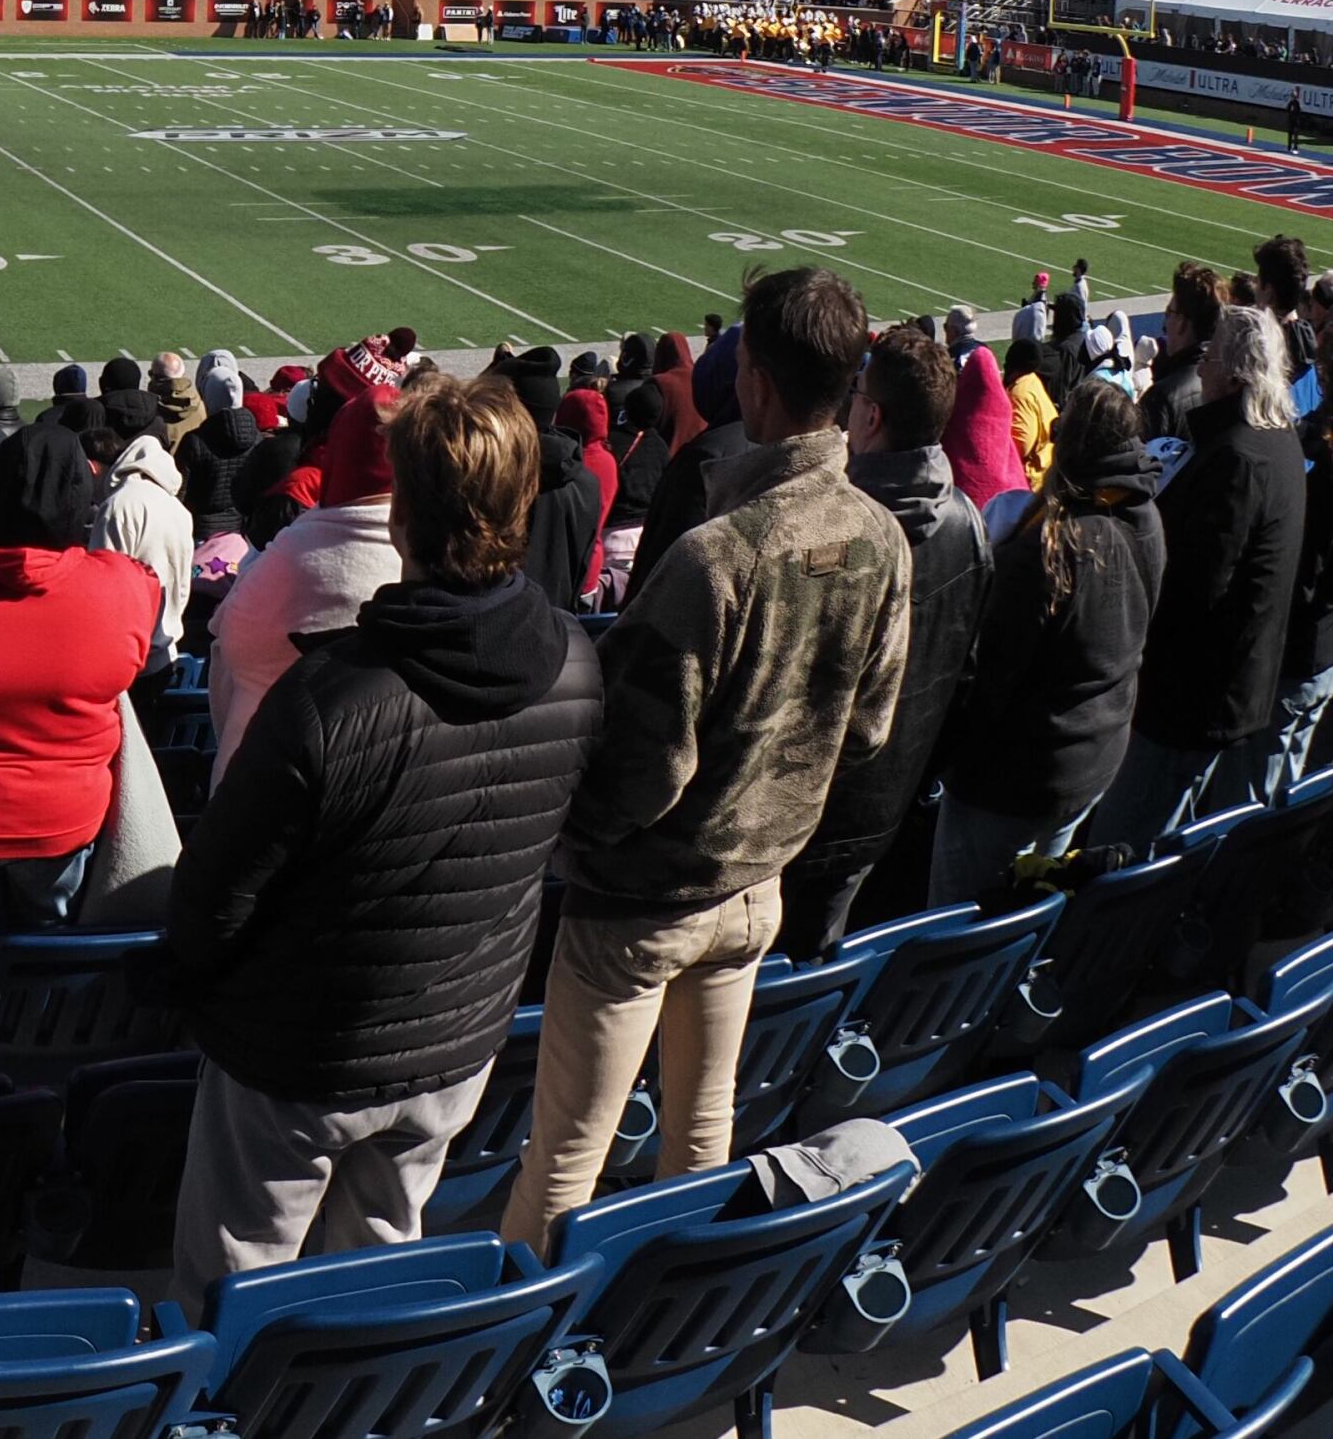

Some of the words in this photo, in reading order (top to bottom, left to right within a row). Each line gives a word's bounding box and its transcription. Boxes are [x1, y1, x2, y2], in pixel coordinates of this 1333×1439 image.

[101, 3, 126, 12] ZEBRA
[553, 4, 578, 23] Lite
[1101, 60, 1129, 76] ULT
[1197, 76, 1239, 95] ULTRA
[1011, 213, 1122, 233] 10
[707, 228, 847, 252] 20
[312, 243, 478, 266] 30
